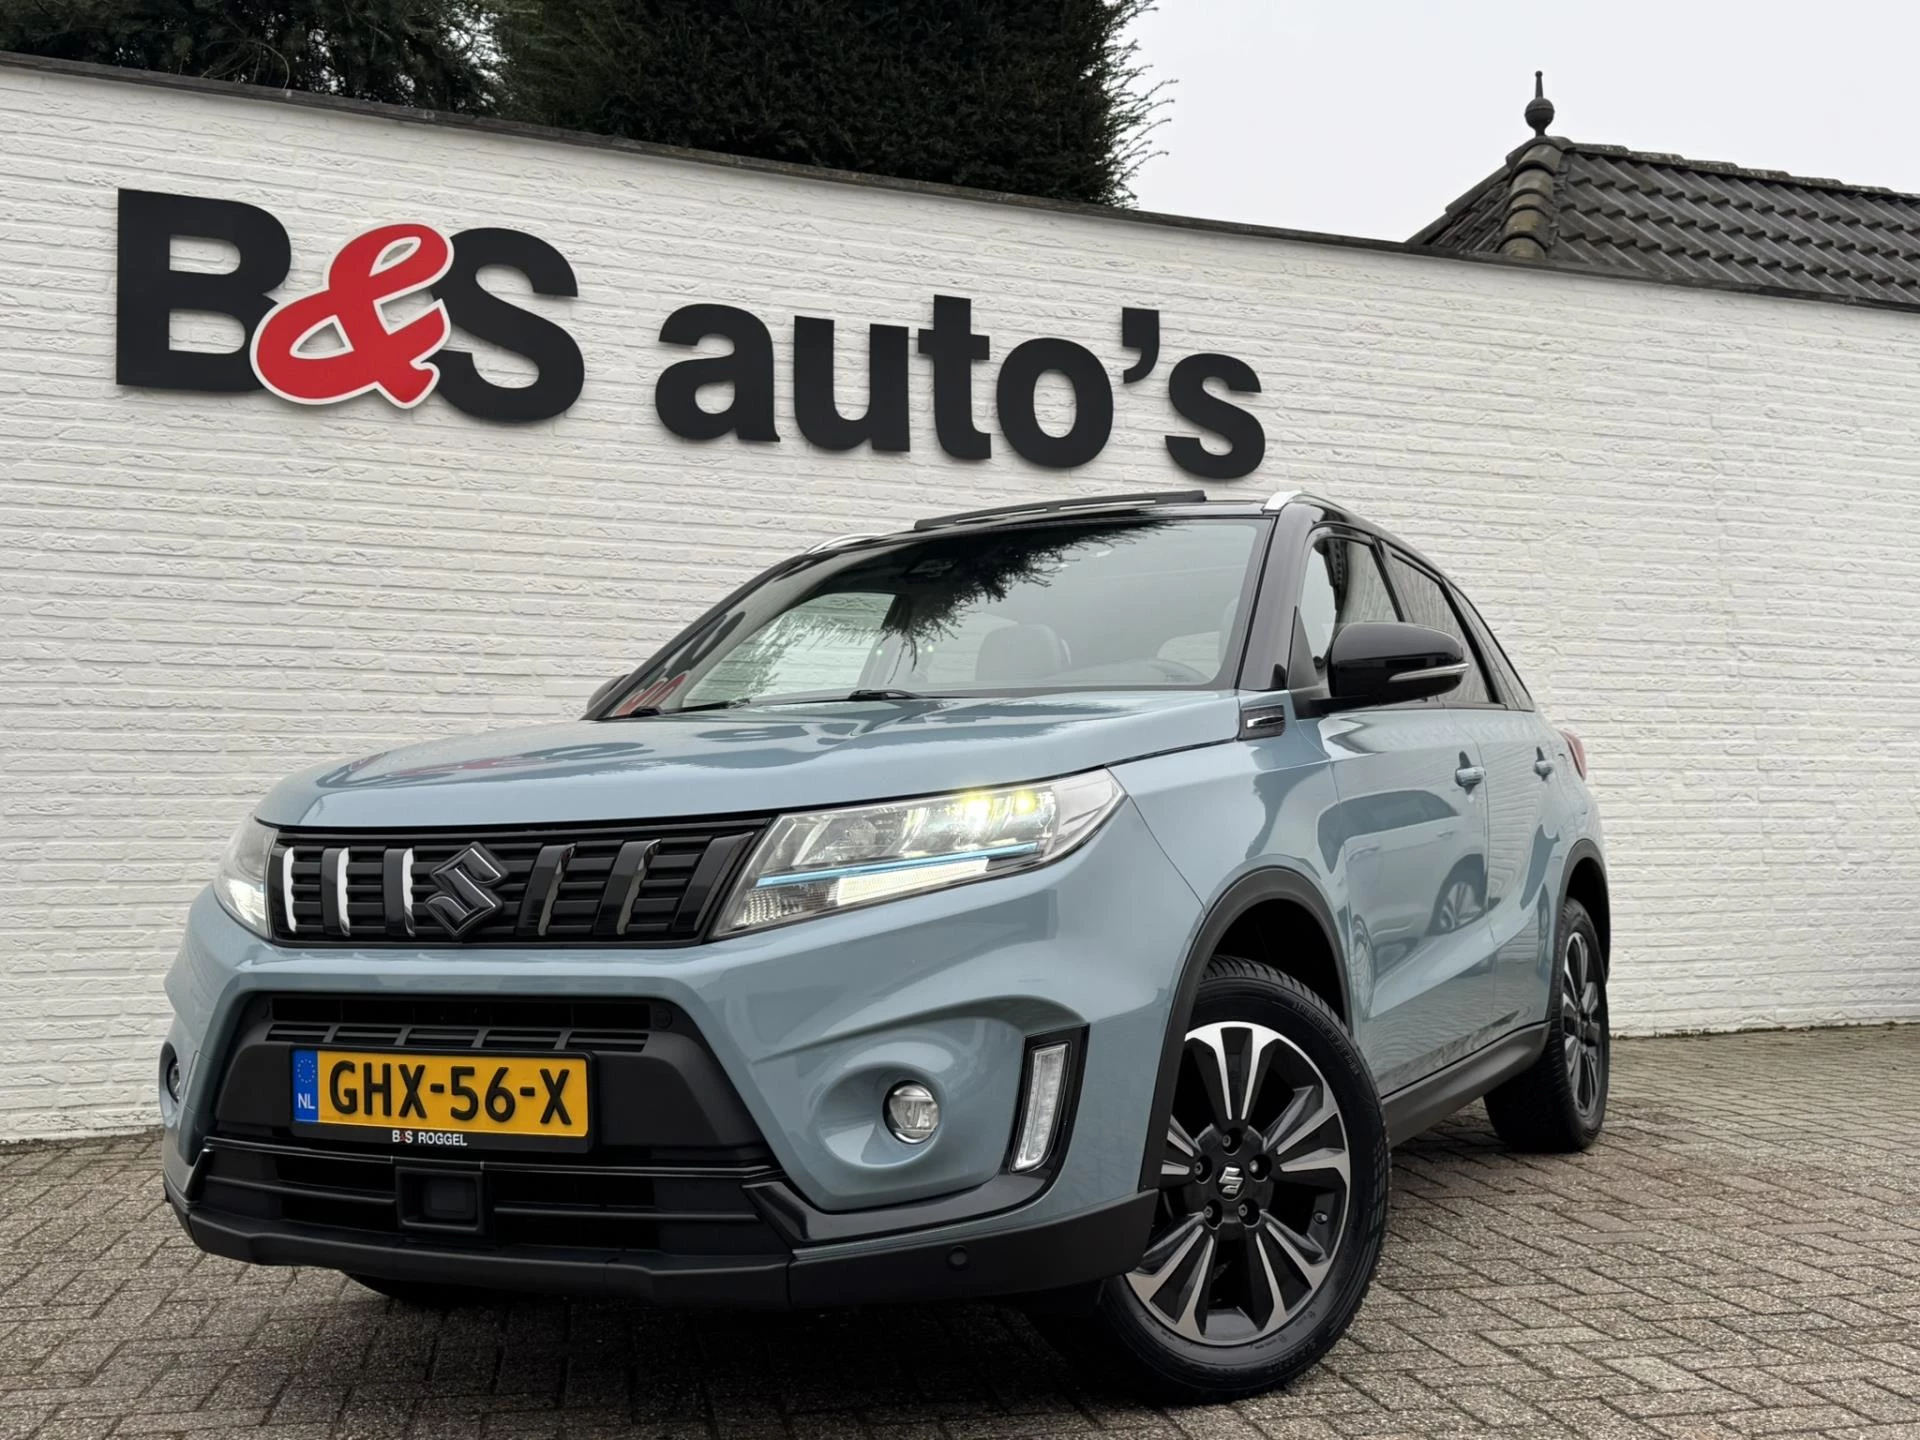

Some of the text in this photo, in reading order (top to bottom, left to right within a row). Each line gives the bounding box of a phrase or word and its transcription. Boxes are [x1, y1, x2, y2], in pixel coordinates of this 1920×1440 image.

[116, 188, 1266, 479] B&S auto's
[297, 1093, 316, 1110] NL
[329, 1060, 573, 1126] GHX-56-X
[418, 1132, 468, 1147] ROGGEL
